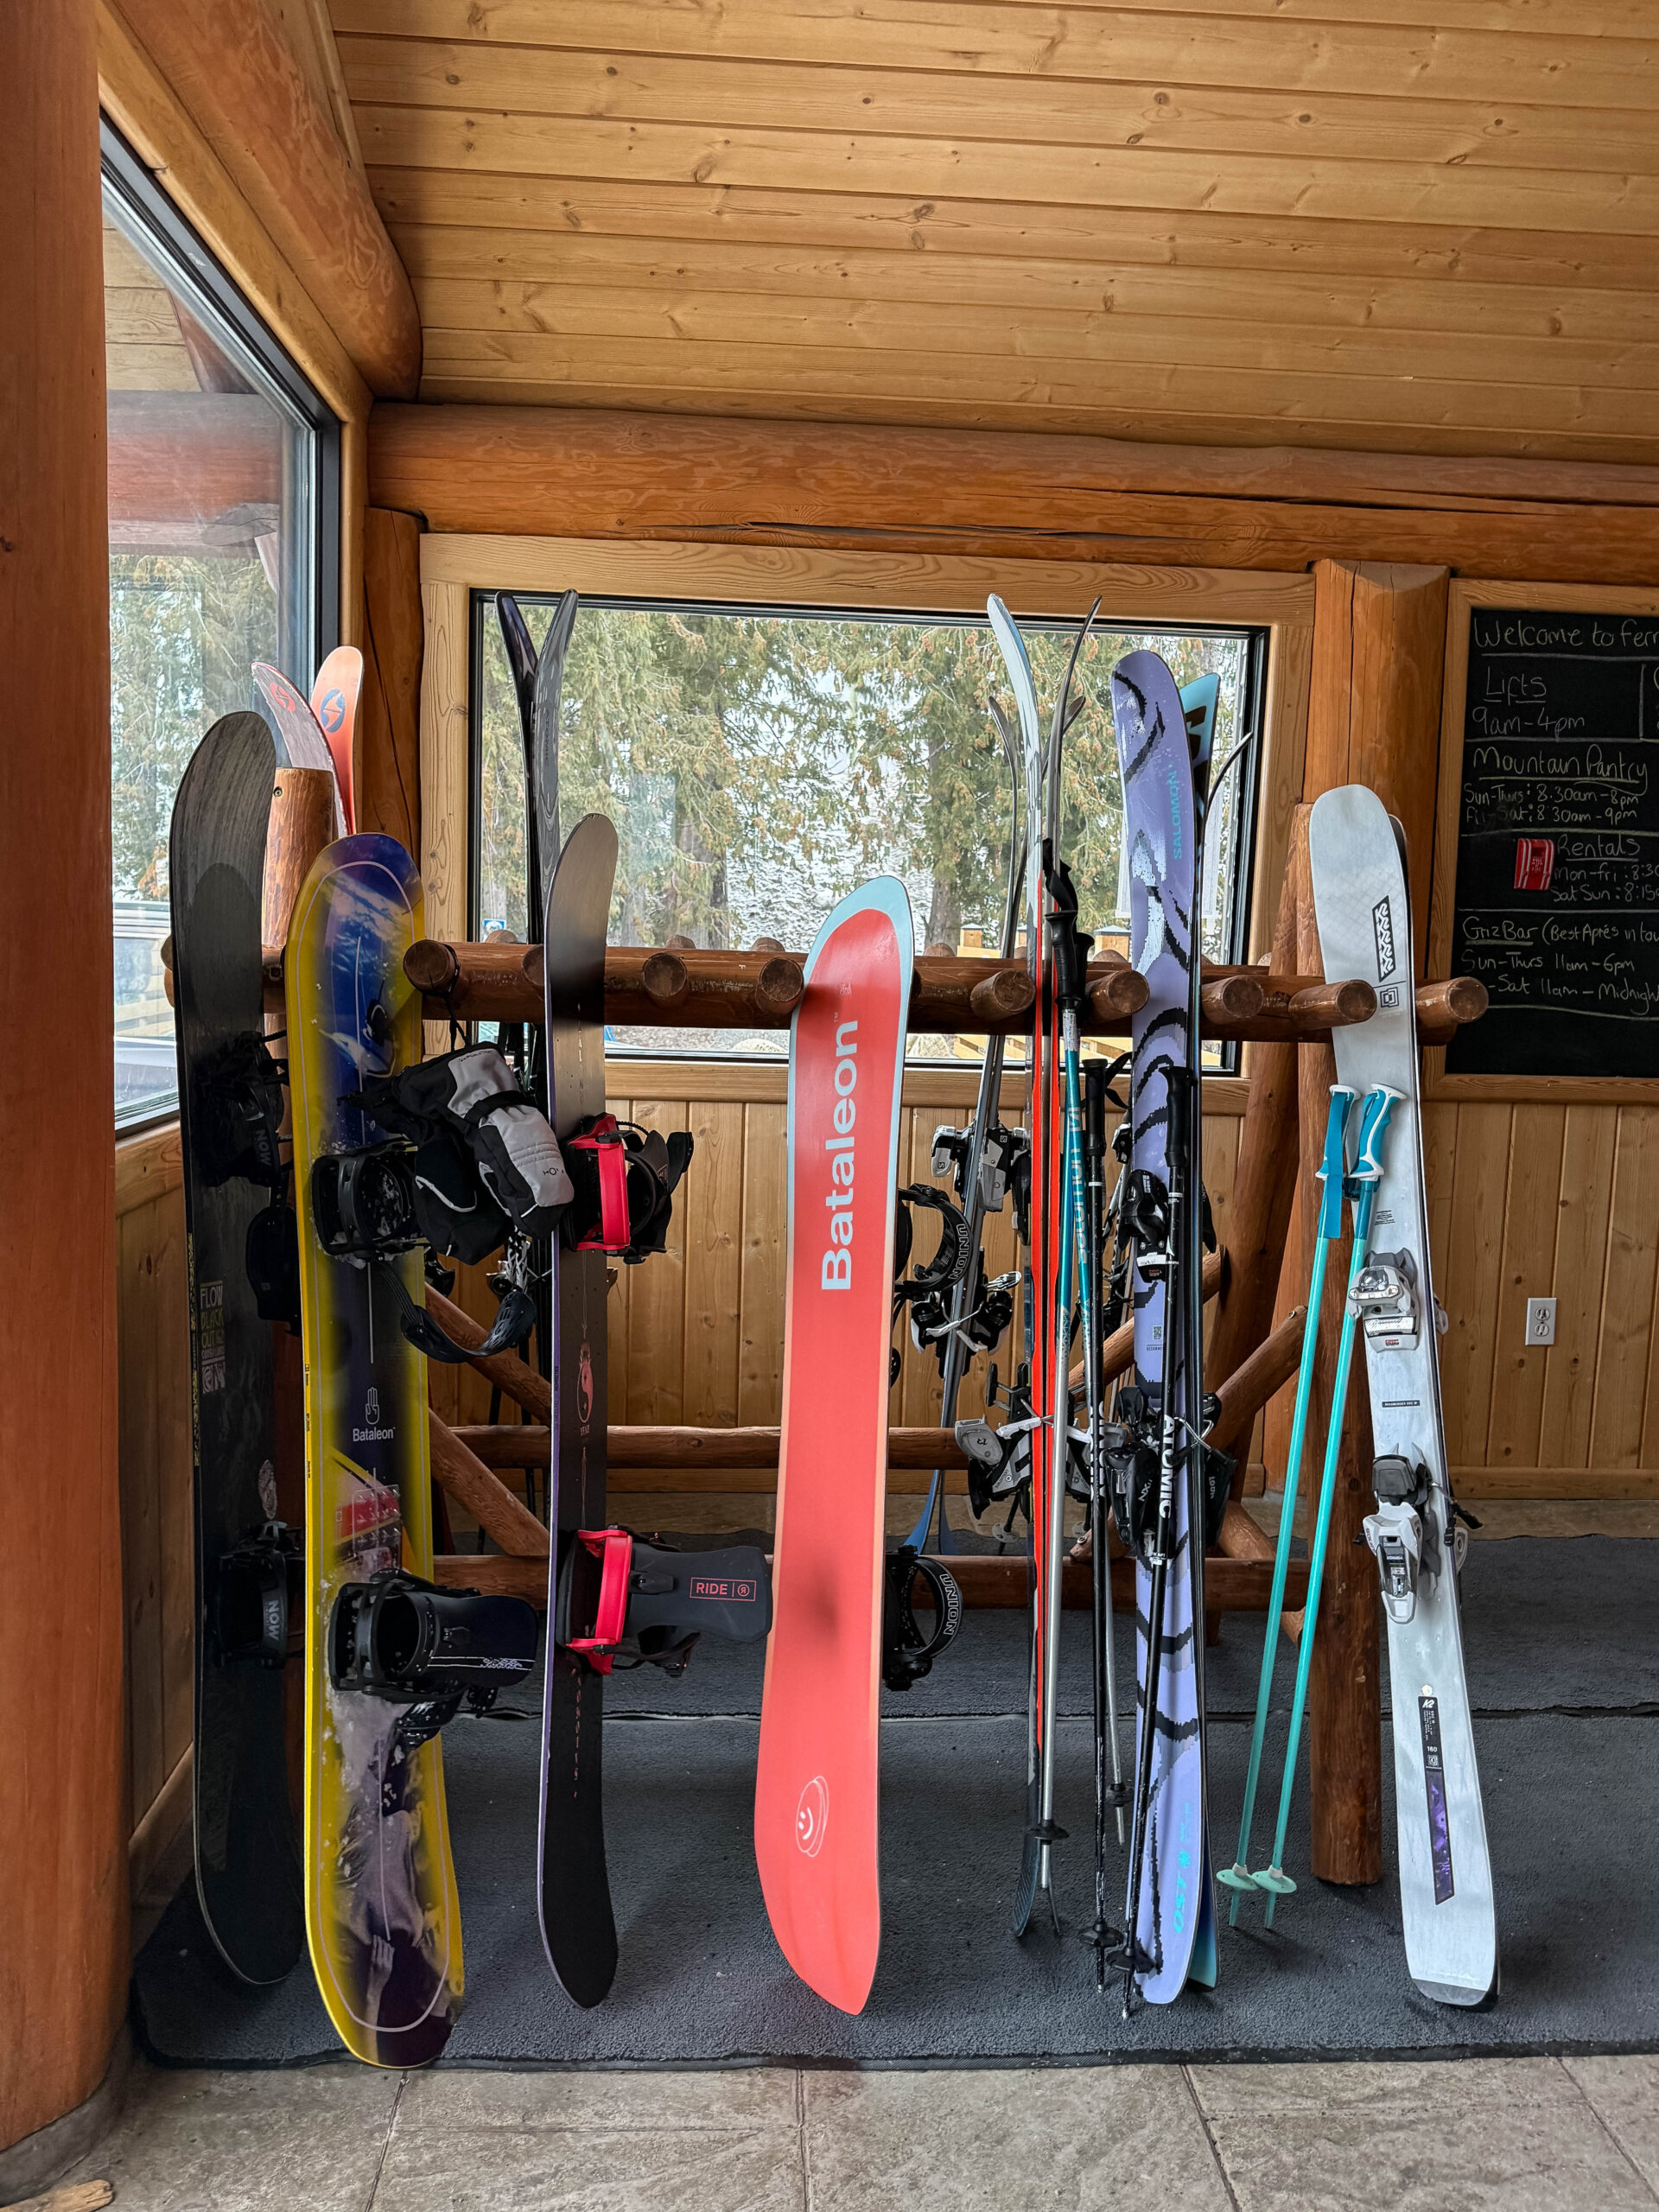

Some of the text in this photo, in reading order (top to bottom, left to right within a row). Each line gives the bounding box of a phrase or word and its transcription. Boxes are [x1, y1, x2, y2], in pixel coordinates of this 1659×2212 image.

[1474, 617, 1583, 648] Welcome
[1592, 621, 1614, 646] to
[1485, 666, 1547, 705] Lifts
[1472, 706, 1585, 741] 9am-4pm
[1473, 744, 1648, 785] Mountain Pantry
[1169, 769, 1182, 860] SALOMON
[1605, 807, 1637, 825] 9pm
[1557, 834, 1641, 856] Rentals
[1550, 885, 1578, 902] Sat
[1624, 930, 1637, 942] in
[1555, 953, 1588, 972] 11am
[1603, 953, 1635, 976] 6pm
[1541, 977, 1578, 995] 11am
[255, 1128, 272, 1166] NOW
[821, 1020, 858, 1290] Bataleon
[948, 1224, 967, 1280] UNION
[200, 1285, 224, 1309] FLOW
[200, 1308, 225, 1332] BLACK
[353, 1427, 394, 1442] Bataleon
[1159, 1414, 1175, 1519] ATOMIC
[695, 1582, 728, 1596] RIDE
[939, 1573, 959, 1635] UNION
[267, 1599, 280, 1641] NOW
[1422, 1699, 1435, 1708] K2
